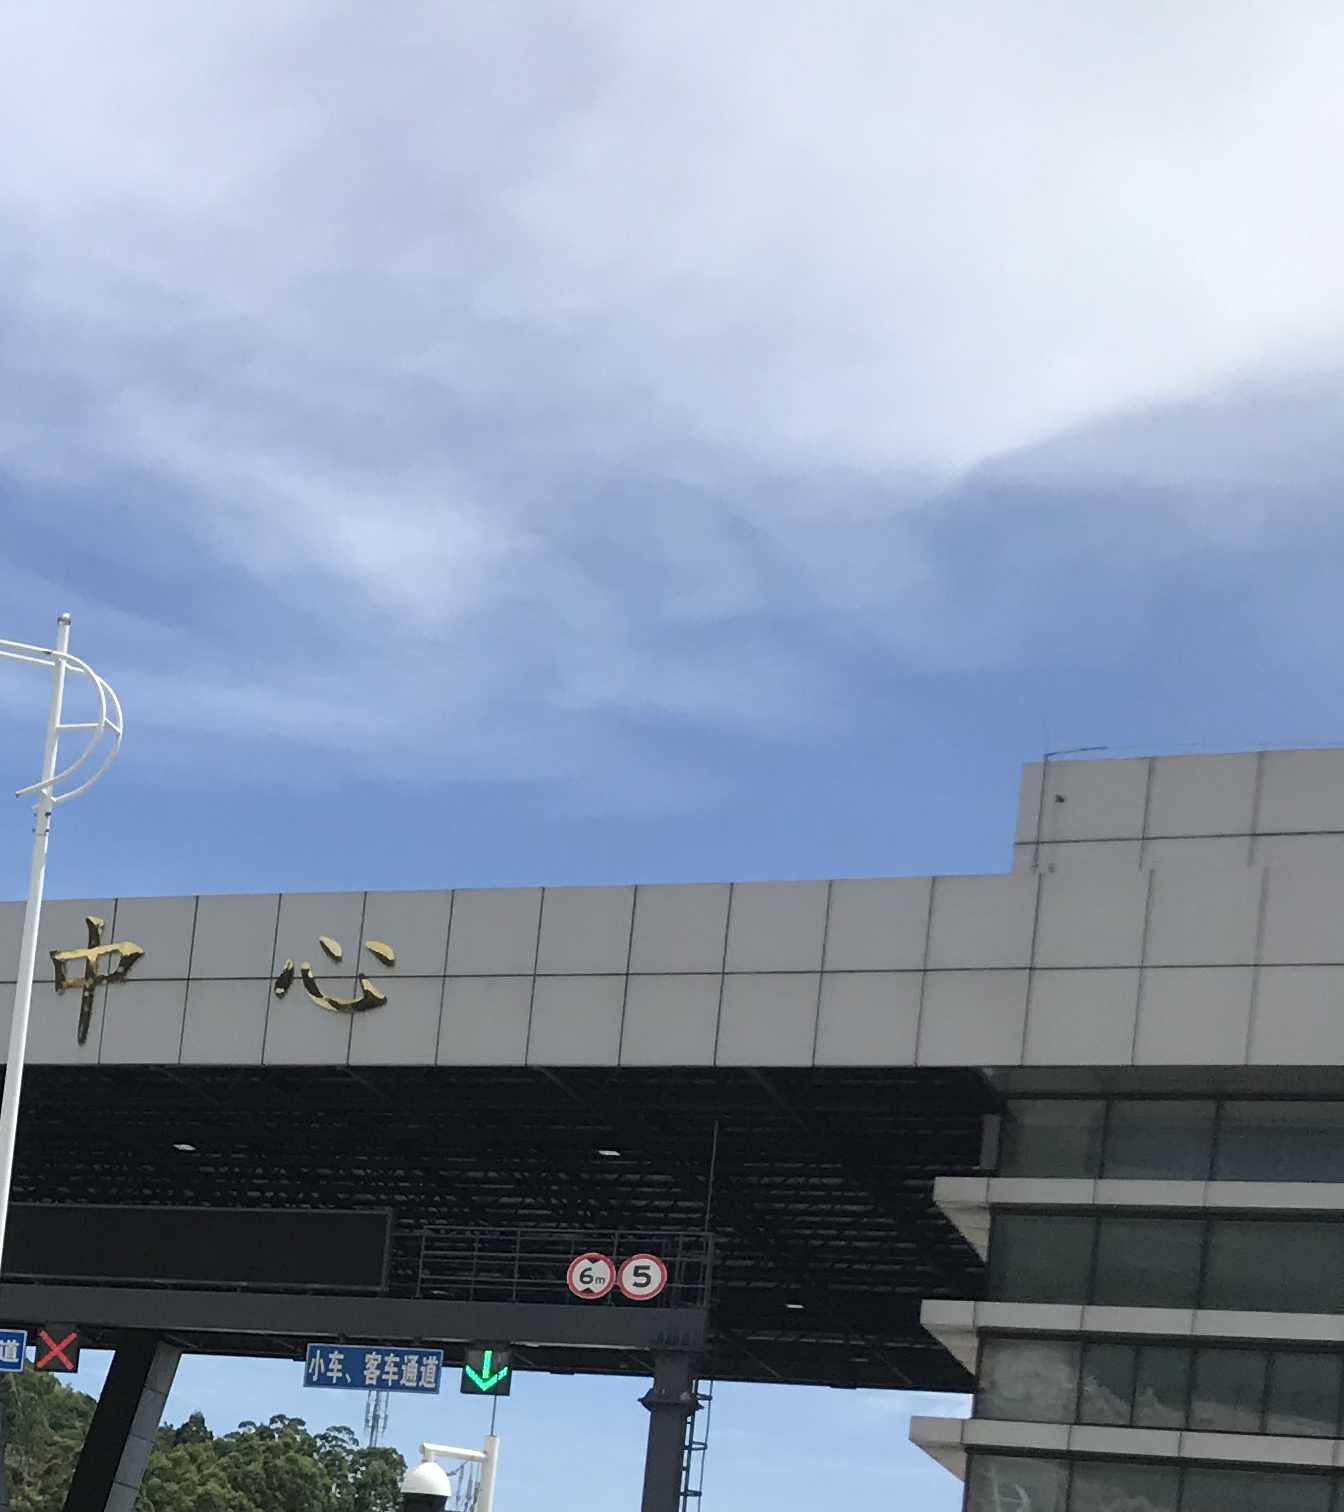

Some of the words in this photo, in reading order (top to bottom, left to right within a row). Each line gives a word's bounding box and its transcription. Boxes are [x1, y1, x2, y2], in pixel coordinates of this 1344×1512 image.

[579, 1267, 606, 1285] 6m
[632, 1265, 652, 1288] 5
[308, 1349, 439, 1388] 小车、客车通道
